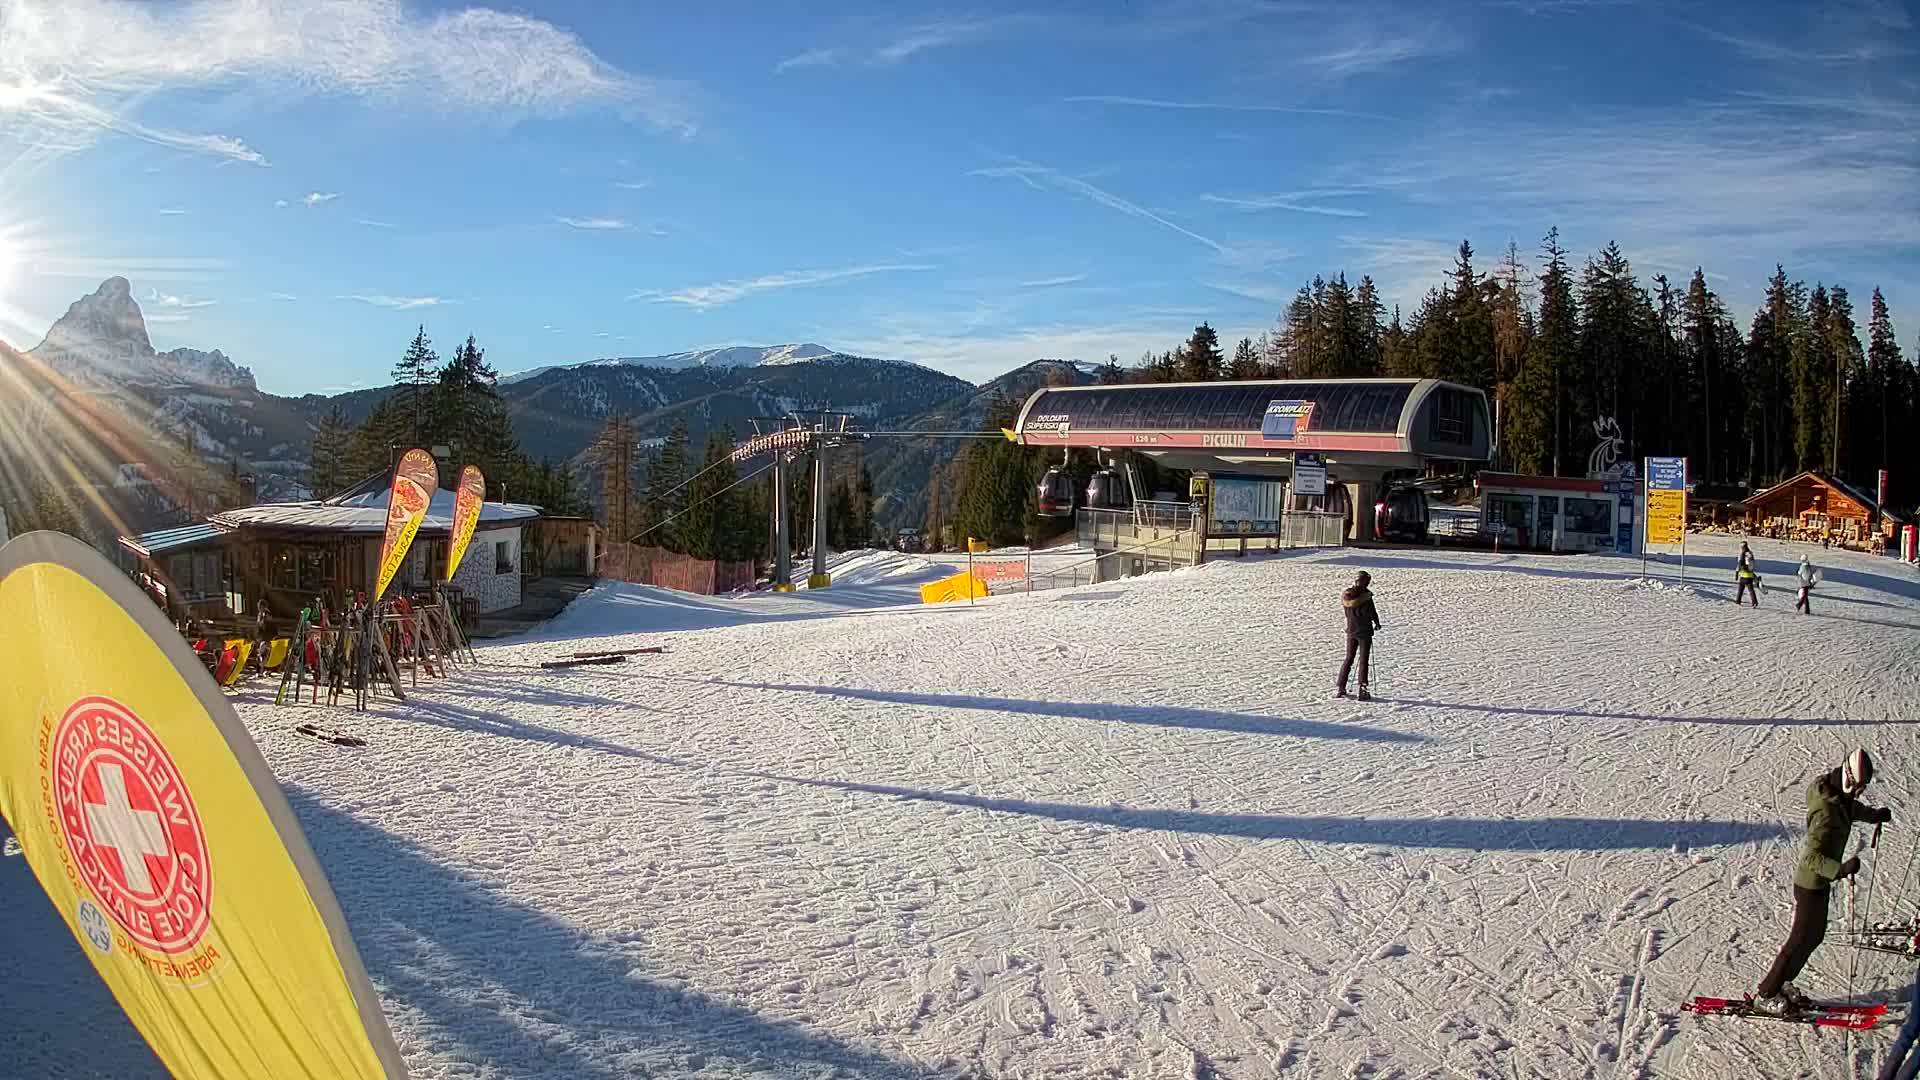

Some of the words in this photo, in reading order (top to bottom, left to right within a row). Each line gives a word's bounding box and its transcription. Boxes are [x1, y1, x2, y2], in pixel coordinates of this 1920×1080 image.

[1266, 405, 1310, 414] KRONPLATZ
[1037, 414, 1069, 422] DOLOMITI
[1026, 422, 1059, 430] SUPERSKI
[1202, 434, 1246, 448] PICULIN
[379, 520, 418, 586] RESTAURANT
